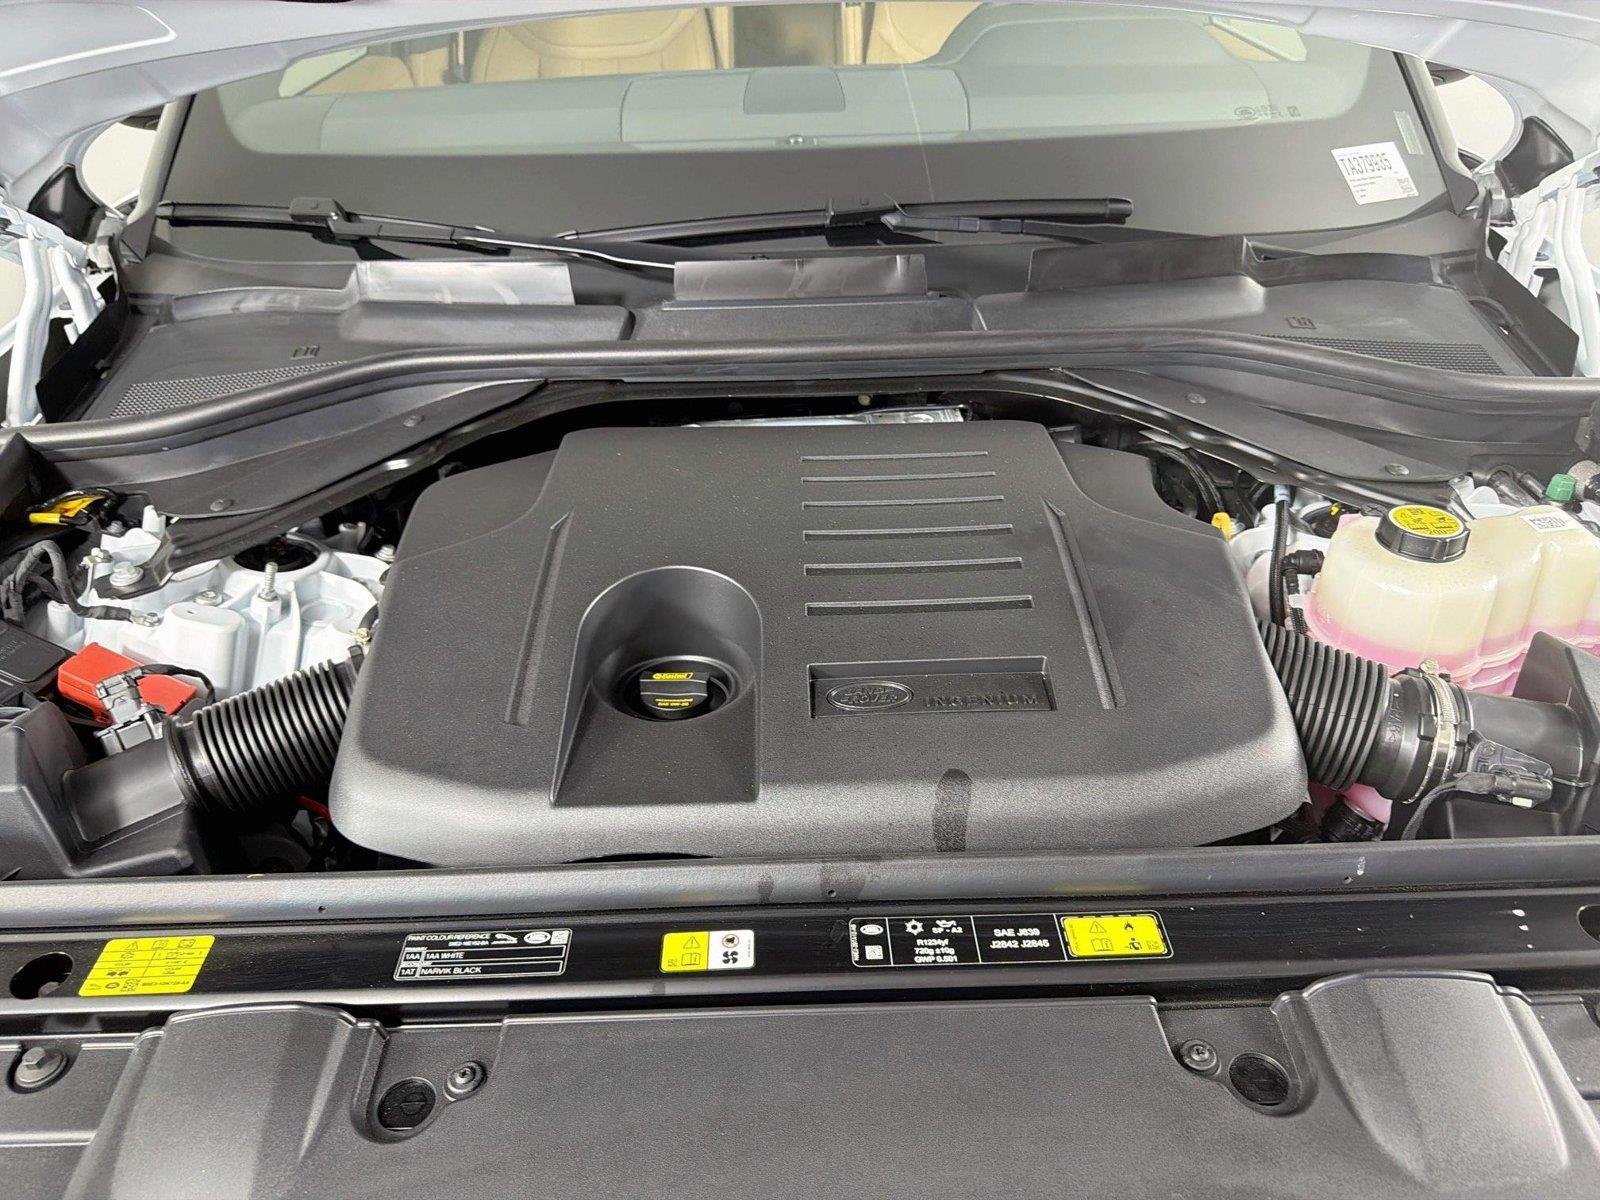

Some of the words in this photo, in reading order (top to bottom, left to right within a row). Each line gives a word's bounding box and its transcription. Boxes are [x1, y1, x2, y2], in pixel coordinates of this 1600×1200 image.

[994, 929, 1015, 937] SAE
[990, 940, 1019, 949] J2842
[1020, 939, 1049, 948] J2845
